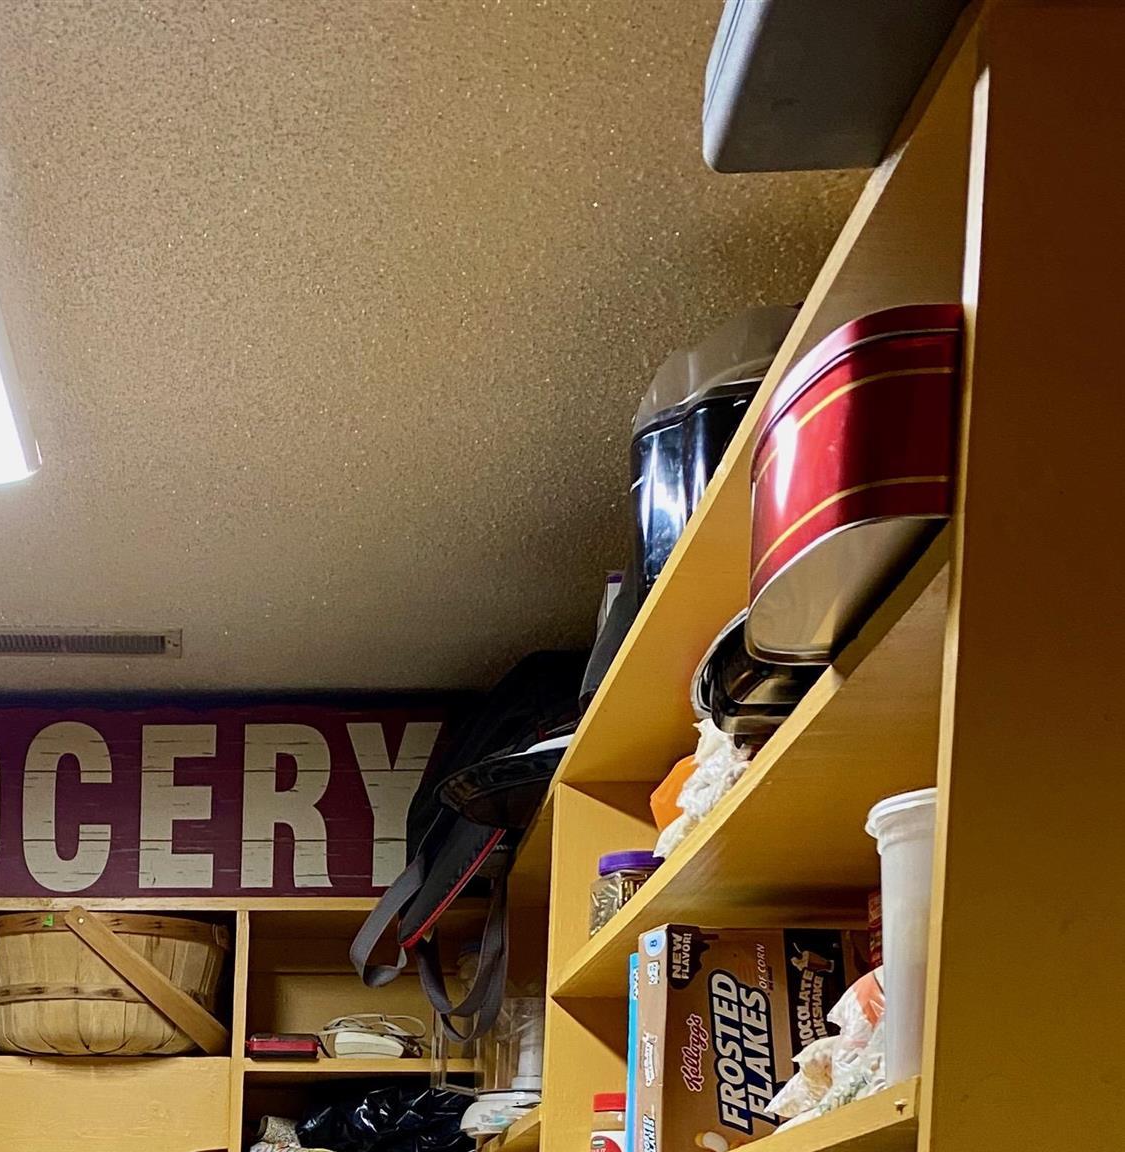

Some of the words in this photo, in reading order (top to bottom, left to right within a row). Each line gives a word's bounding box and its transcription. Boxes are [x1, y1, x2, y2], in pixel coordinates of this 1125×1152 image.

[672, 932, 684, 979] NEW
[681, 932, 692, 979] FLAVOR!
[756, 943, 766, 971] CORN
[759, 971, 768, 989] OF
[794, 968, 816, 1048] HOCOLATE
[680, 1013, 709, 1092] Kellogg's
[711, 973, 748, 1130] FROSTED
[740, 987, 777, 1119] FLAKES
